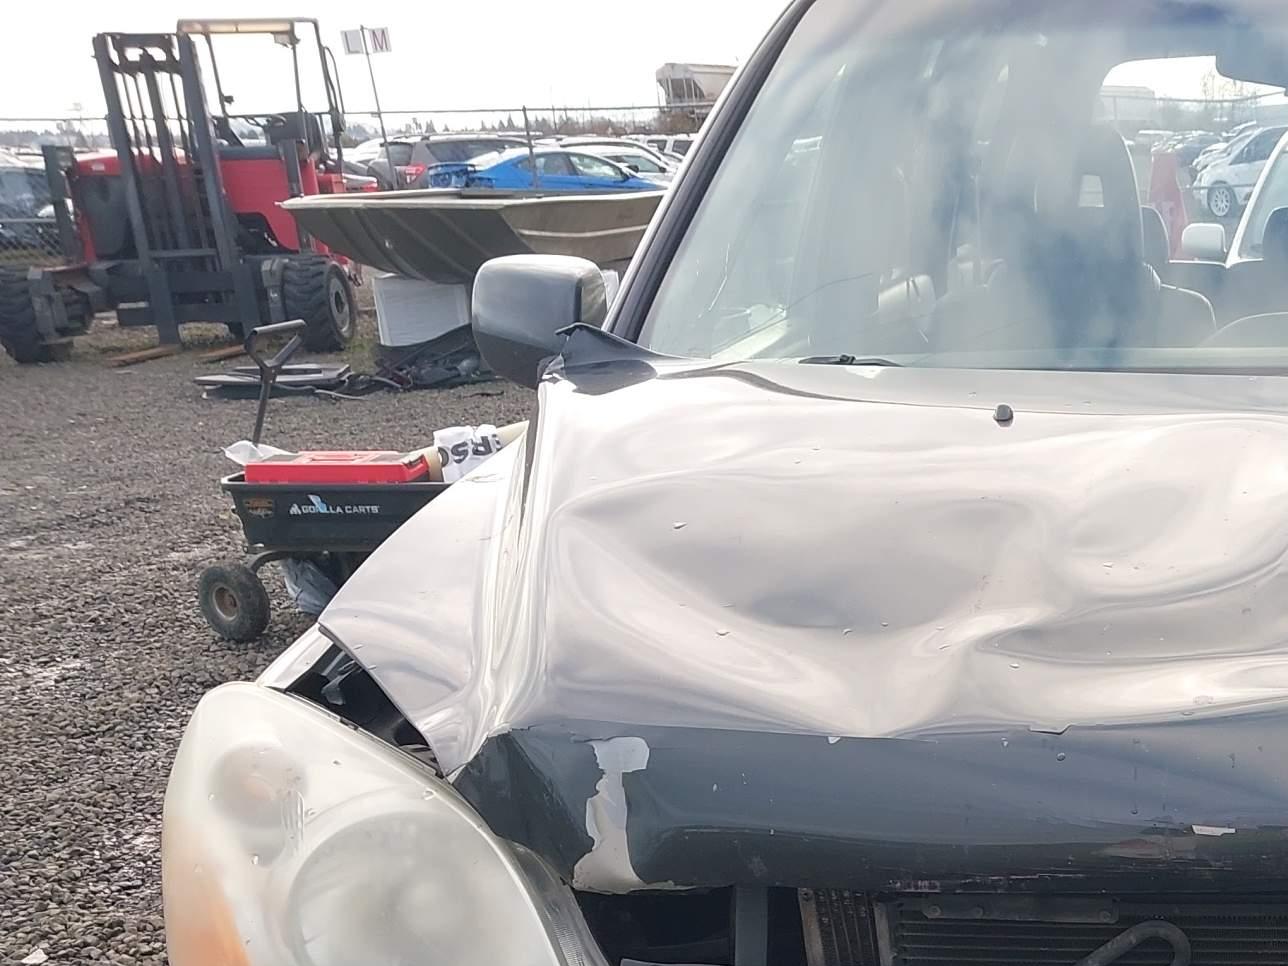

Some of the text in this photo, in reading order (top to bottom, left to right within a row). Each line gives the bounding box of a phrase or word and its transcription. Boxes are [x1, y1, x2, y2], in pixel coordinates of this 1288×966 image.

[344, 31, 361, 55] L
[372, 28, 389, 51] M
[344, 504, 379, 514] CARTS
